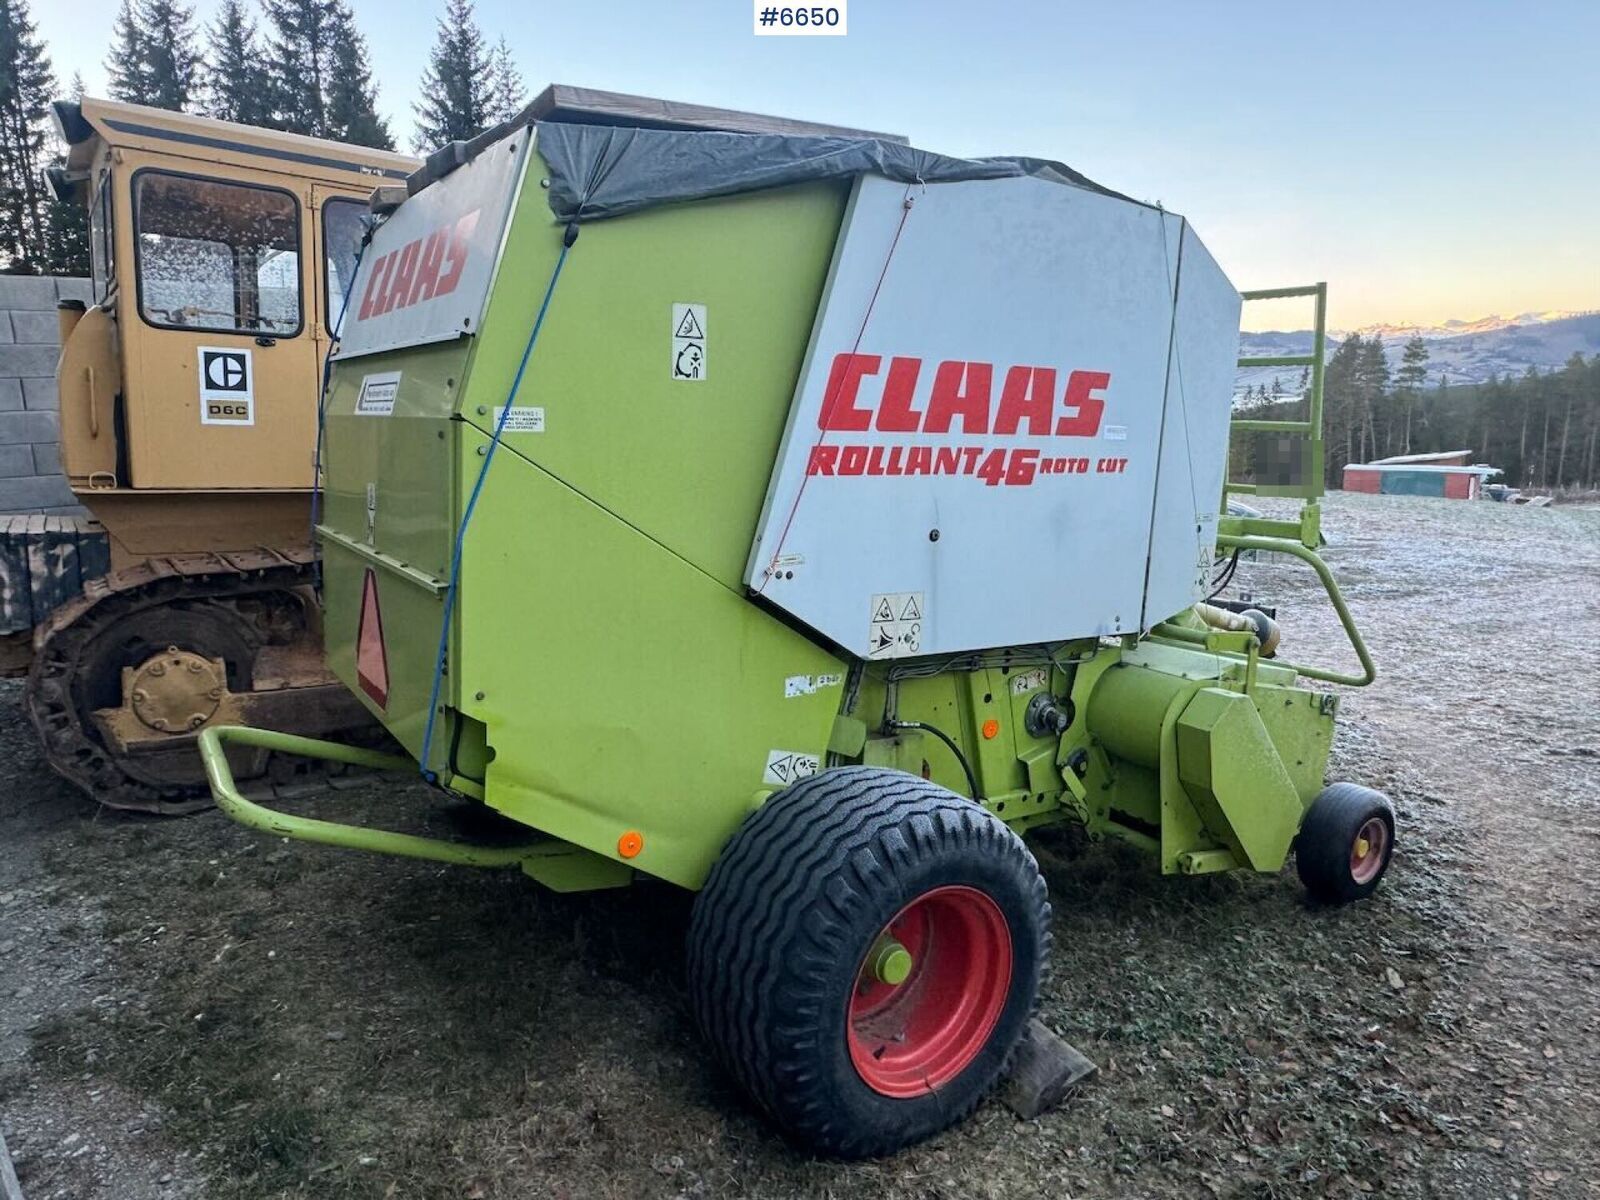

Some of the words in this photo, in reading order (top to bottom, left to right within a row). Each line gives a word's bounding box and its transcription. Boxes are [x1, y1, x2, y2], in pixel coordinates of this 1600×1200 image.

[358, 208, 481, 321] CLAAS
[209, 405, 247, 415] D6C
[817, 353, 1111, 437] CLAAS
[1039, 457, 1090, 474] ROTO
[1096, 458, 1128, 473] CUT
